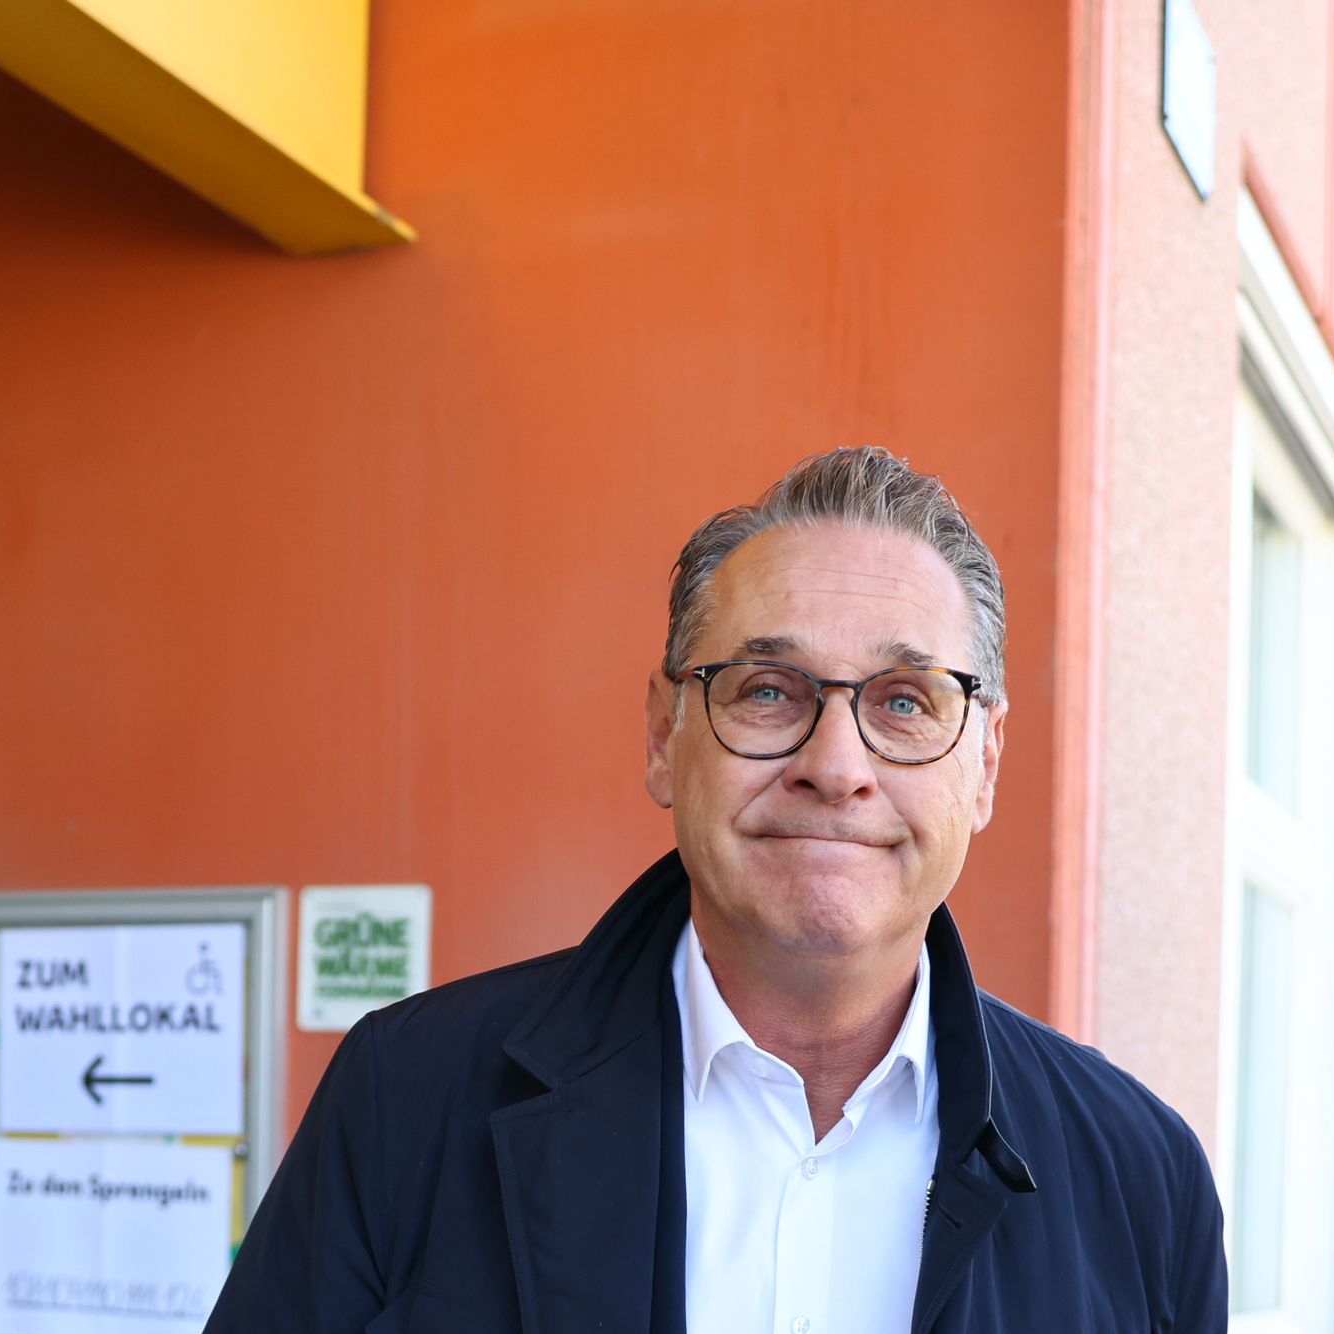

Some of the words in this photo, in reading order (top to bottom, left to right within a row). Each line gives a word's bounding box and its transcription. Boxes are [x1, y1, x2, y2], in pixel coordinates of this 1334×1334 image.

[315, 912, 411, 948] GRÜNE
[17, 958, 88, 989] ZUM
[16, 1003, 222, 1033] WAHLLOKAL
[7, 1170, 33, 1196] Zu
[42, 1172, 82, 1197] den
